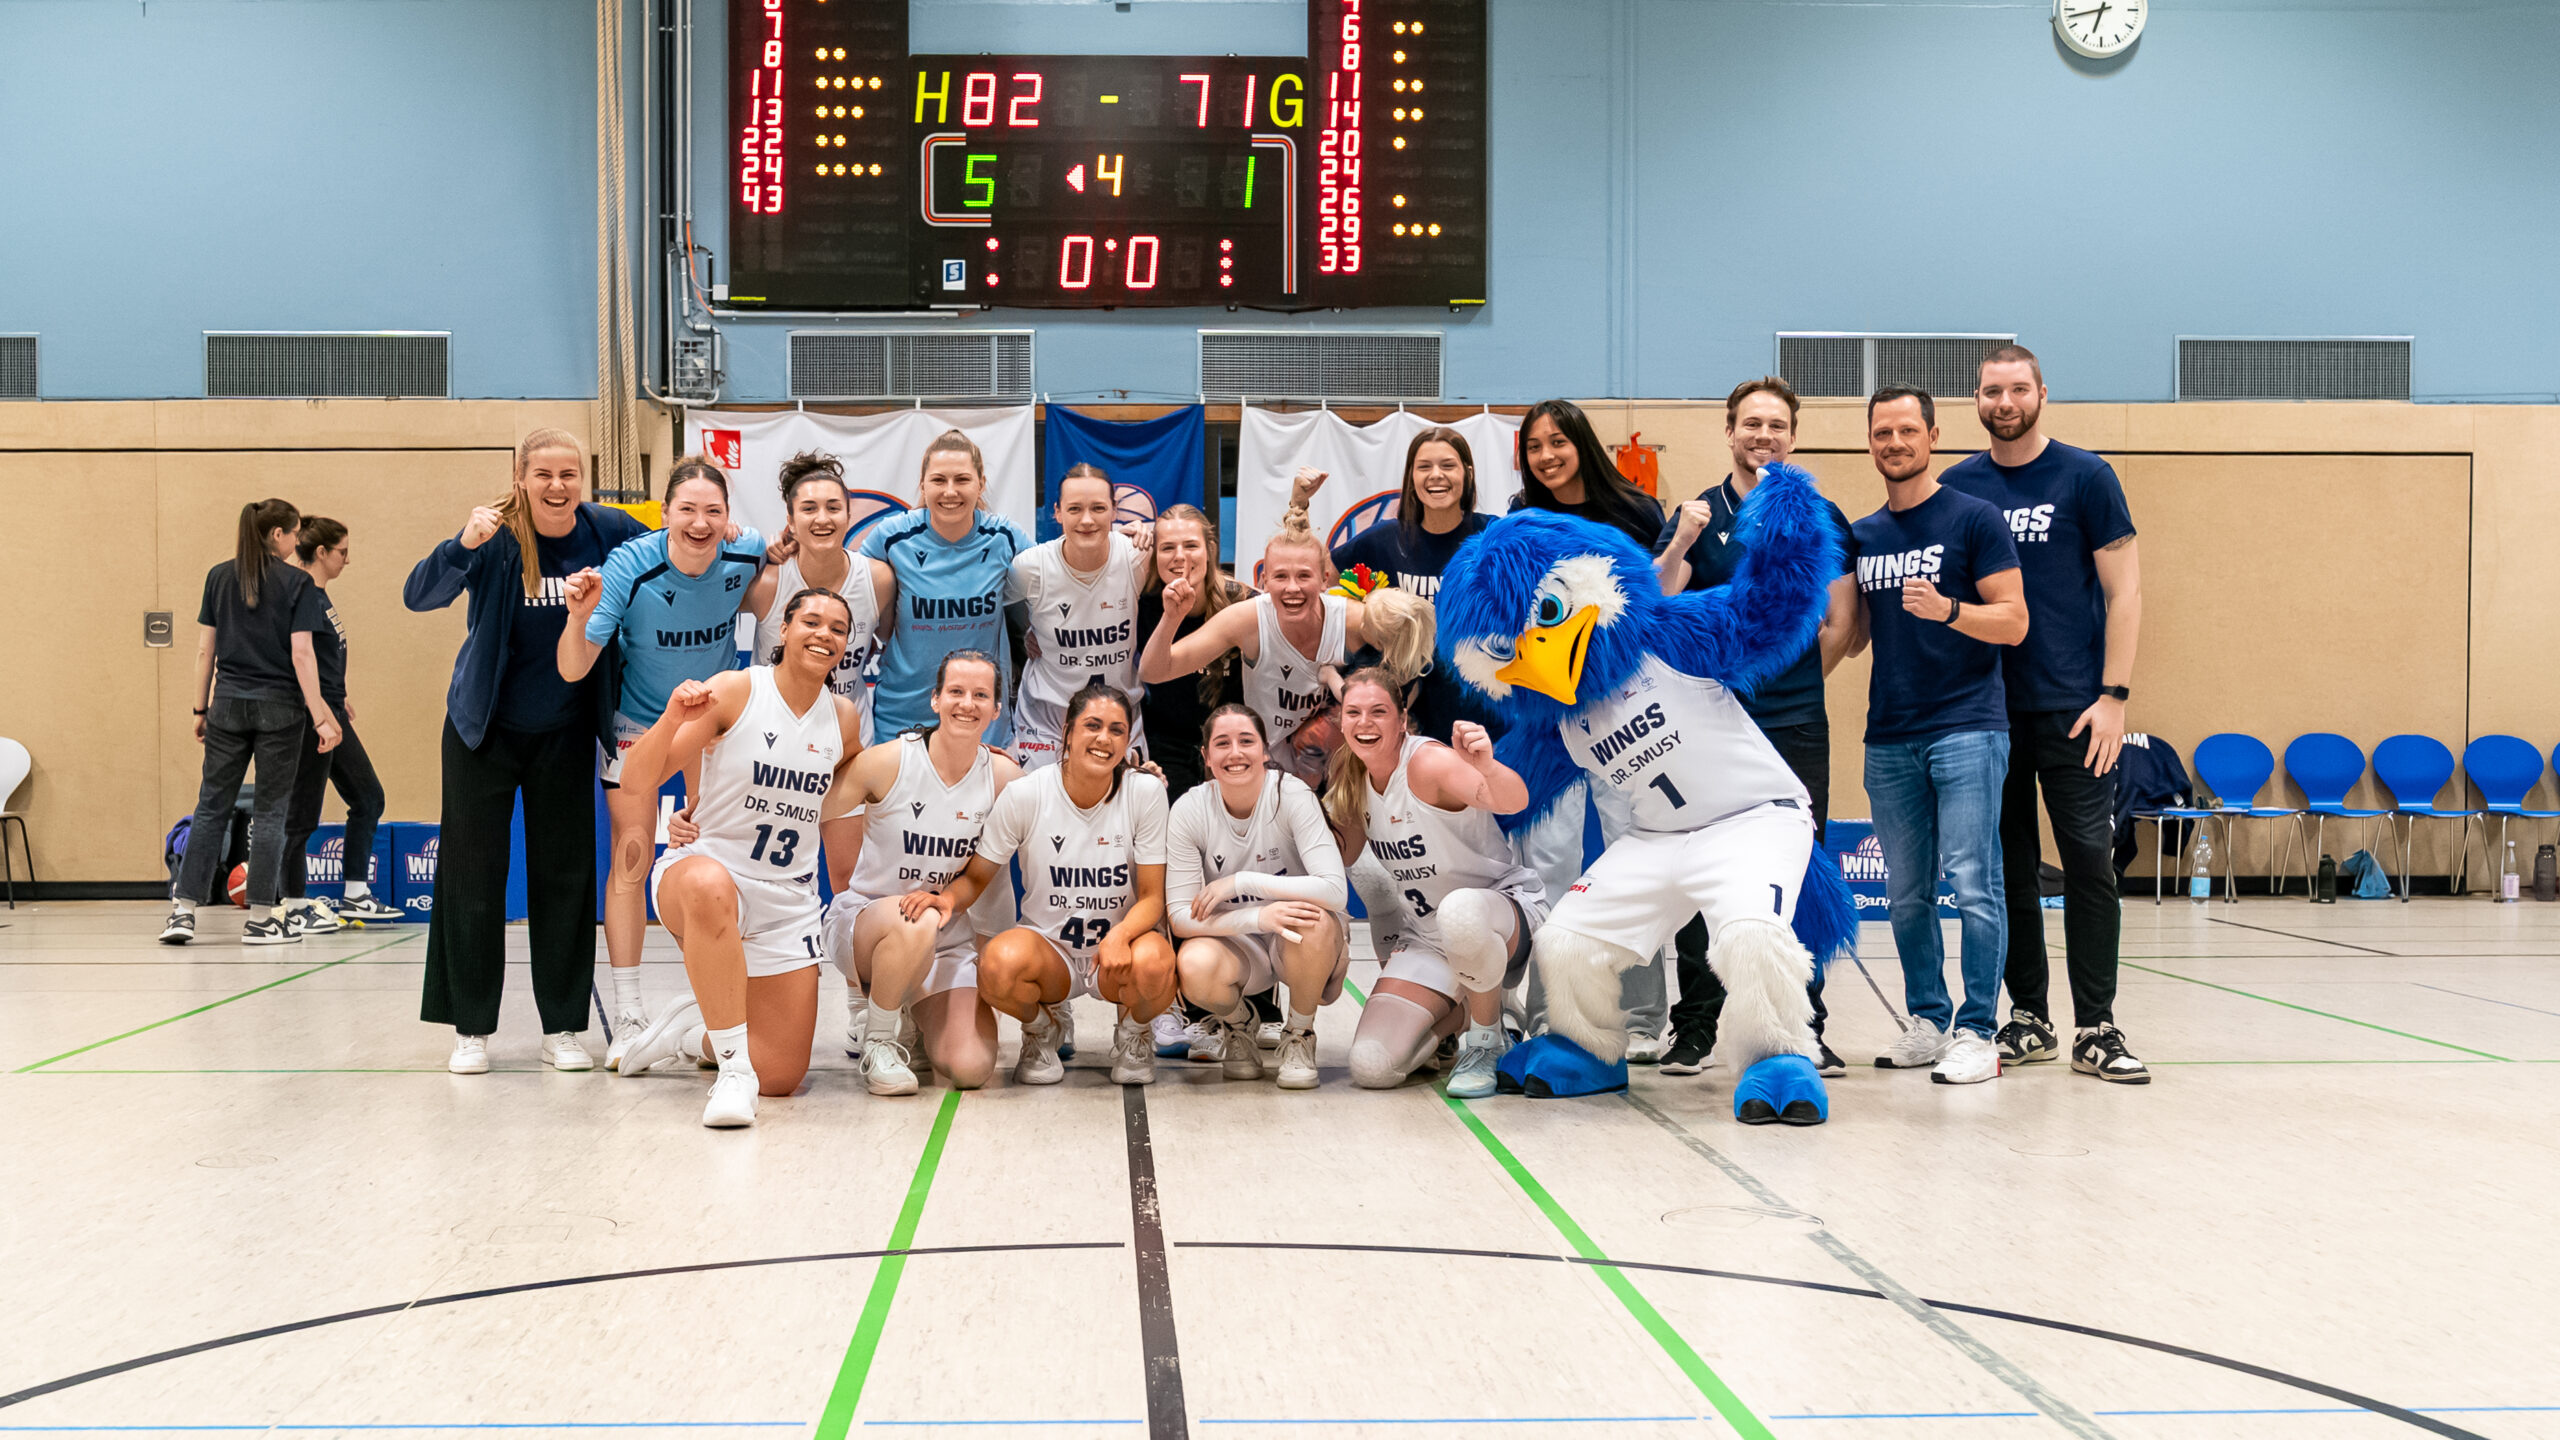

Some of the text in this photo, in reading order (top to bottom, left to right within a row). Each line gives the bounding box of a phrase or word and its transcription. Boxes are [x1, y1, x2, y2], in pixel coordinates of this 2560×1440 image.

[765, 11, 783, 39] 7
[1342, 13, 1361, 41] 6
[764, 40, 783, 68] 8
[1342, 43, 1361, 70] 8
[751, 69, 783, 97] 11
[1329, 72, 1361, 99] 11
[751, 98, 783, 126] 13
[915, 71, 950, 123] H
[963, 73, 1043, 127] 82
[1179, 74, 1256, 128] 71
[1269, 73, 1304, 127] G
[1328, 100, 1361, 128] 14
[741, 127, 783, 155] 22
[1319, 129, 1361, 157] 20
[741, 156, 783, 184] 24
[963, 154, 997, 207] 5
[1097, 154, 1123, 197] 4
[1244, 156, 1256, 208] 1
[1319, 158, 1361, 186] 24
[741, 185, 783, 214] 43
[1319, 187, 1361, 215] 26
[1319, 216, 1361, 244] 29
[1319, 245, 1361, 274] 33
[981, 548, 991, 564] 7
[1856, 543, 1946, 585] WINGS
[724, 574, 742, 593] 22
[910, 590, 998, 620] WINGS
[1054, 618, 1131, 649] WINGS
[1059, 648, 1132, 668] DR. SMUSY
[1018, 740, 1056, 753] wupsi
[1589, 702, 1667, 768] WINGS
[1627, 730, 1682, 773] SMUSY
[752, 760, 832, 796] WINGS
[1648, 772, 1687, 811] 1
[744, 795, 770, 814] DR.
[749, 823, 800, 868] 13
[898, 866, 924, 882] DR.
[1048, 863, 1129, 888] WINGS
[1392, 863, 1438, 882] SMUSY
[1841, 854, 1889, 873] WIN
[1049, 894, 1128, 911] DR. SMUSY
[1404, 888, 1435, 918] 3
[1059, 916, 1112, 950] 43
